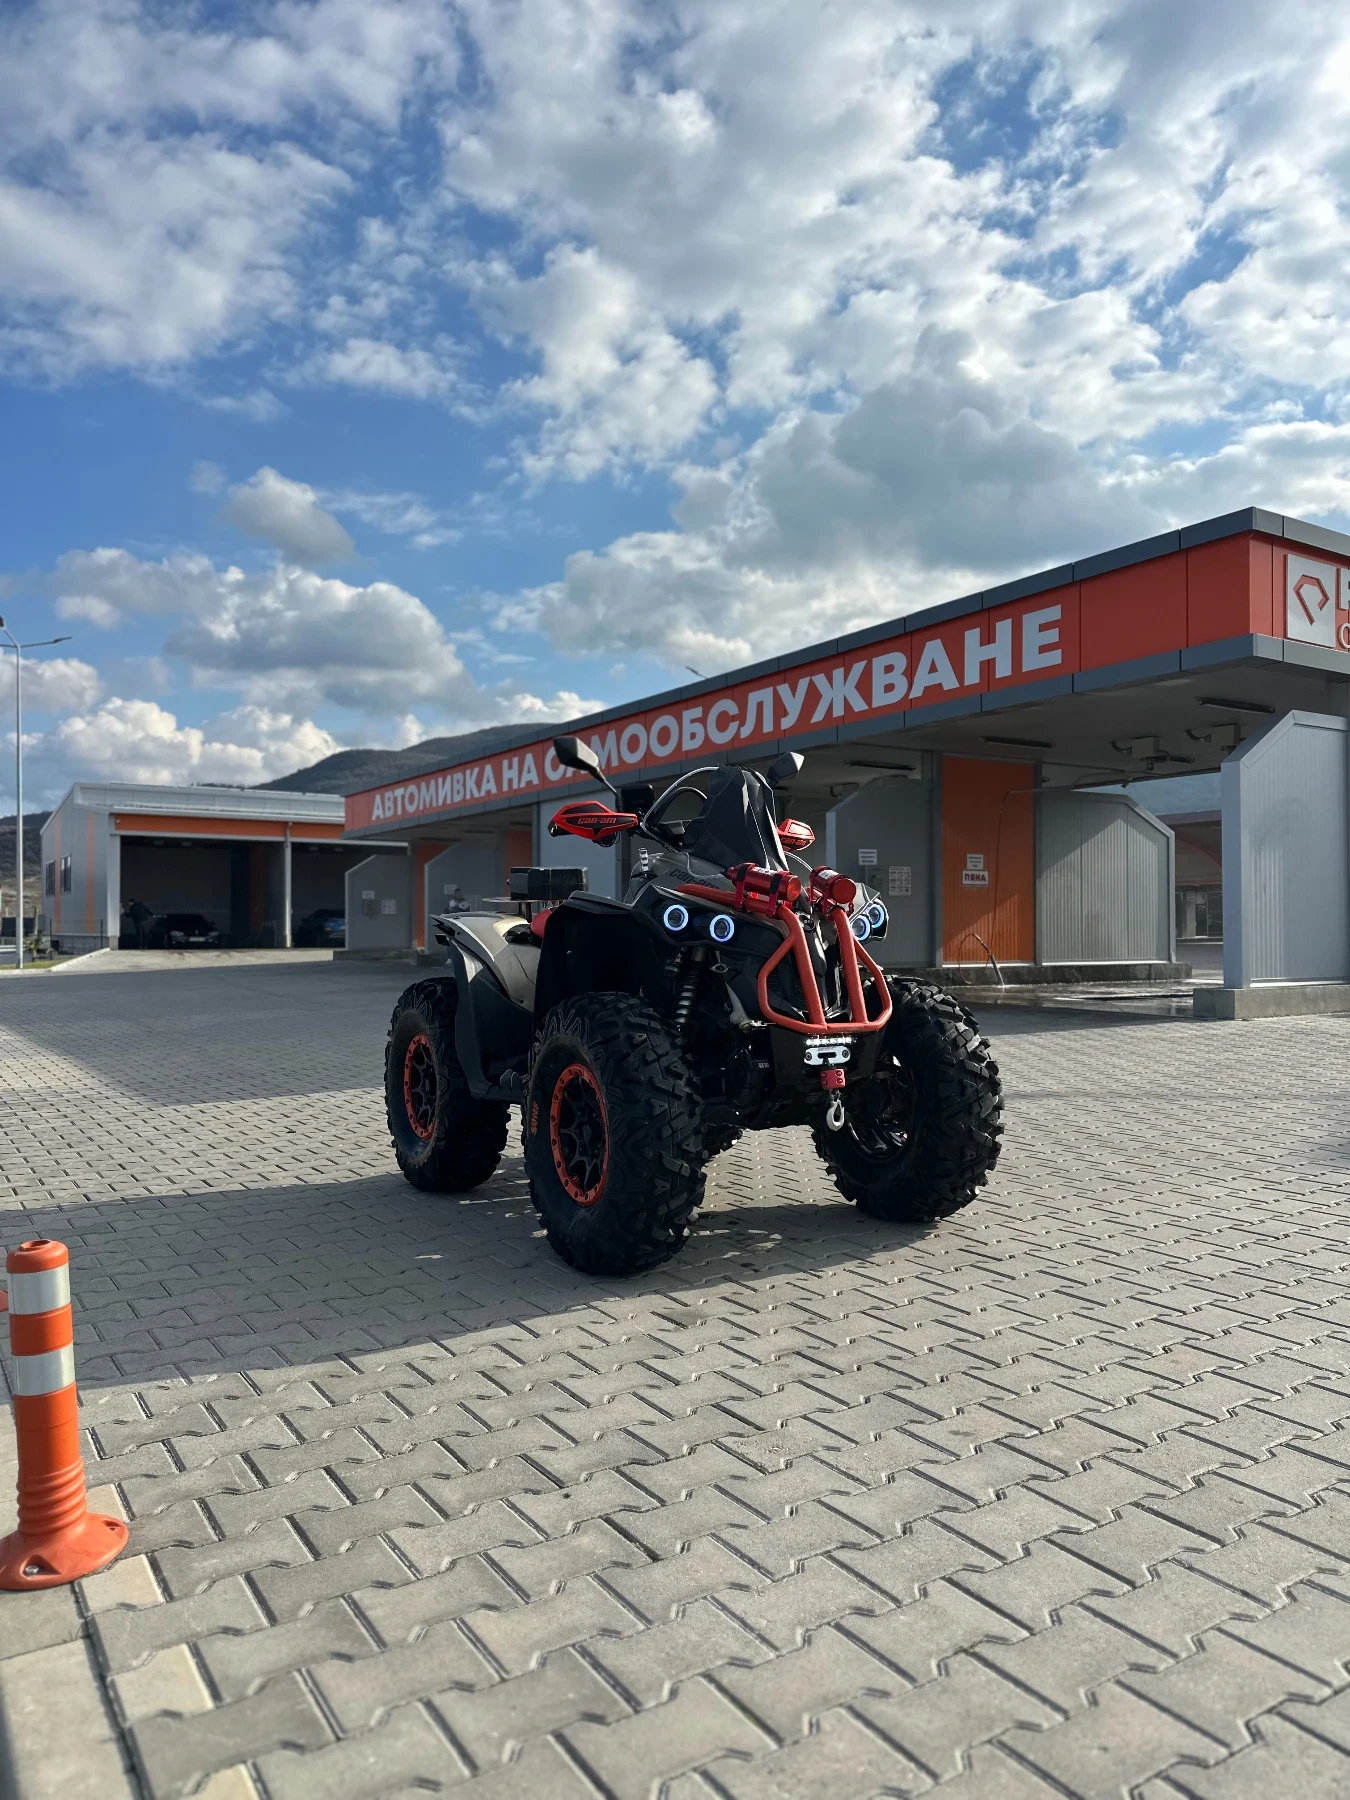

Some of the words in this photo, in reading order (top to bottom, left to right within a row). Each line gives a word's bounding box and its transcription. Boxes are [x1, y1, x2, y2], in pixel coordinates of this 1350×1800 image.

[372, 764, 497, 821] АВТОМИВКА
[502, 753, 539, 791] НА
[544, 604, 1062, 781] СМООБСЛУЖВАНЕ
[964, 873, 987, 882] ПЯНА
